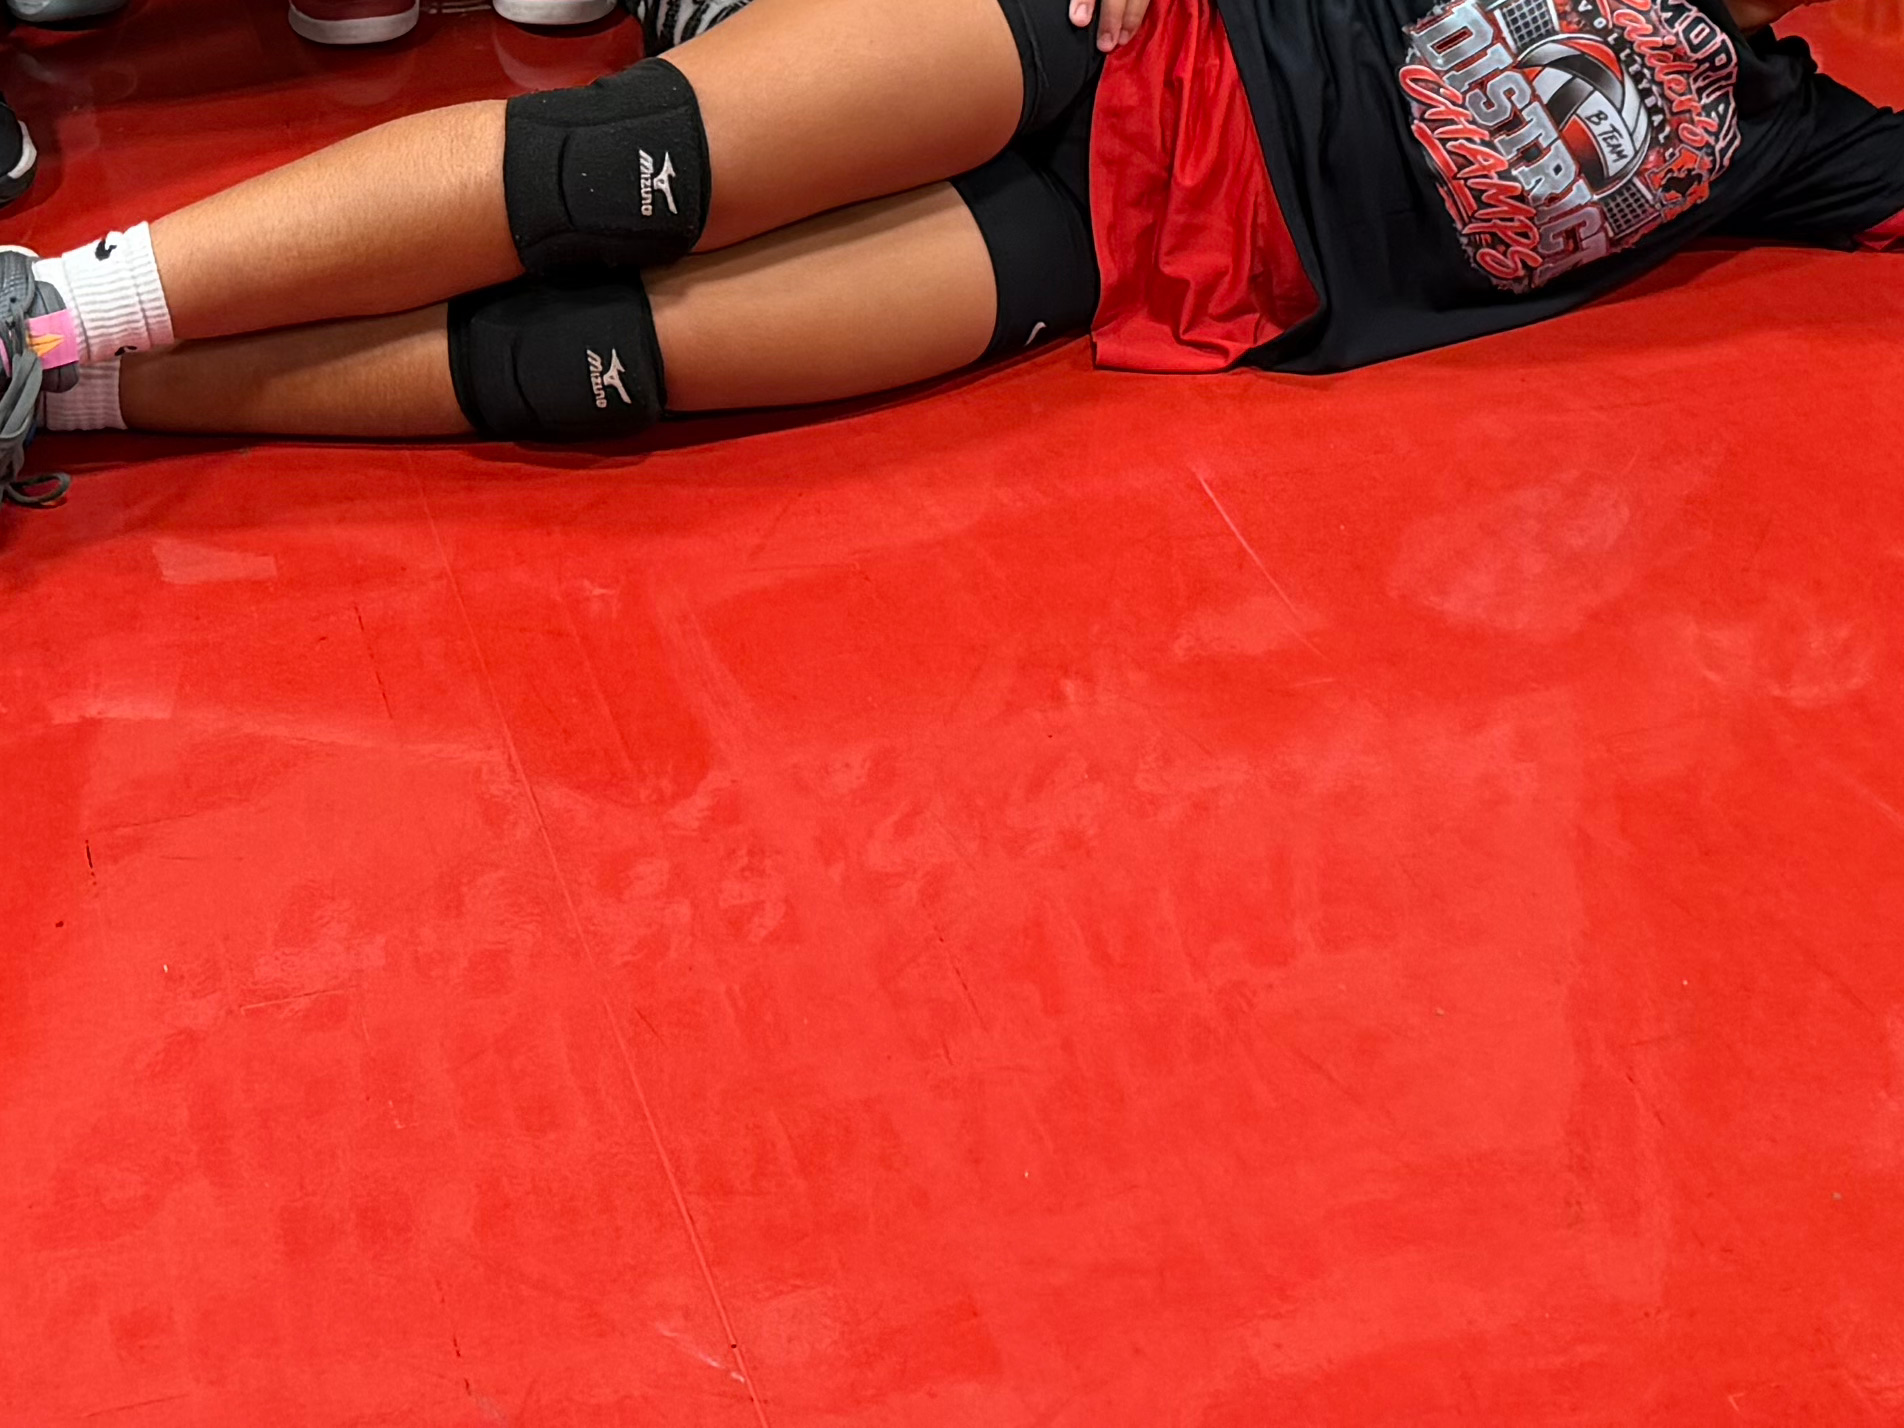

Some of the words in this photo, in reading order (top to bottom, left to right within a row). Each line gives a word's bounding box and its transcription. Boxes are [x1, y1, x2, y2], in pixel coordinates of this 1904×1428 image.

[1399, 64, 1544, 280] CHAMPS
[1584, 109, 1603, 127] B
[1597, 125, 1629, 164] TEAM
